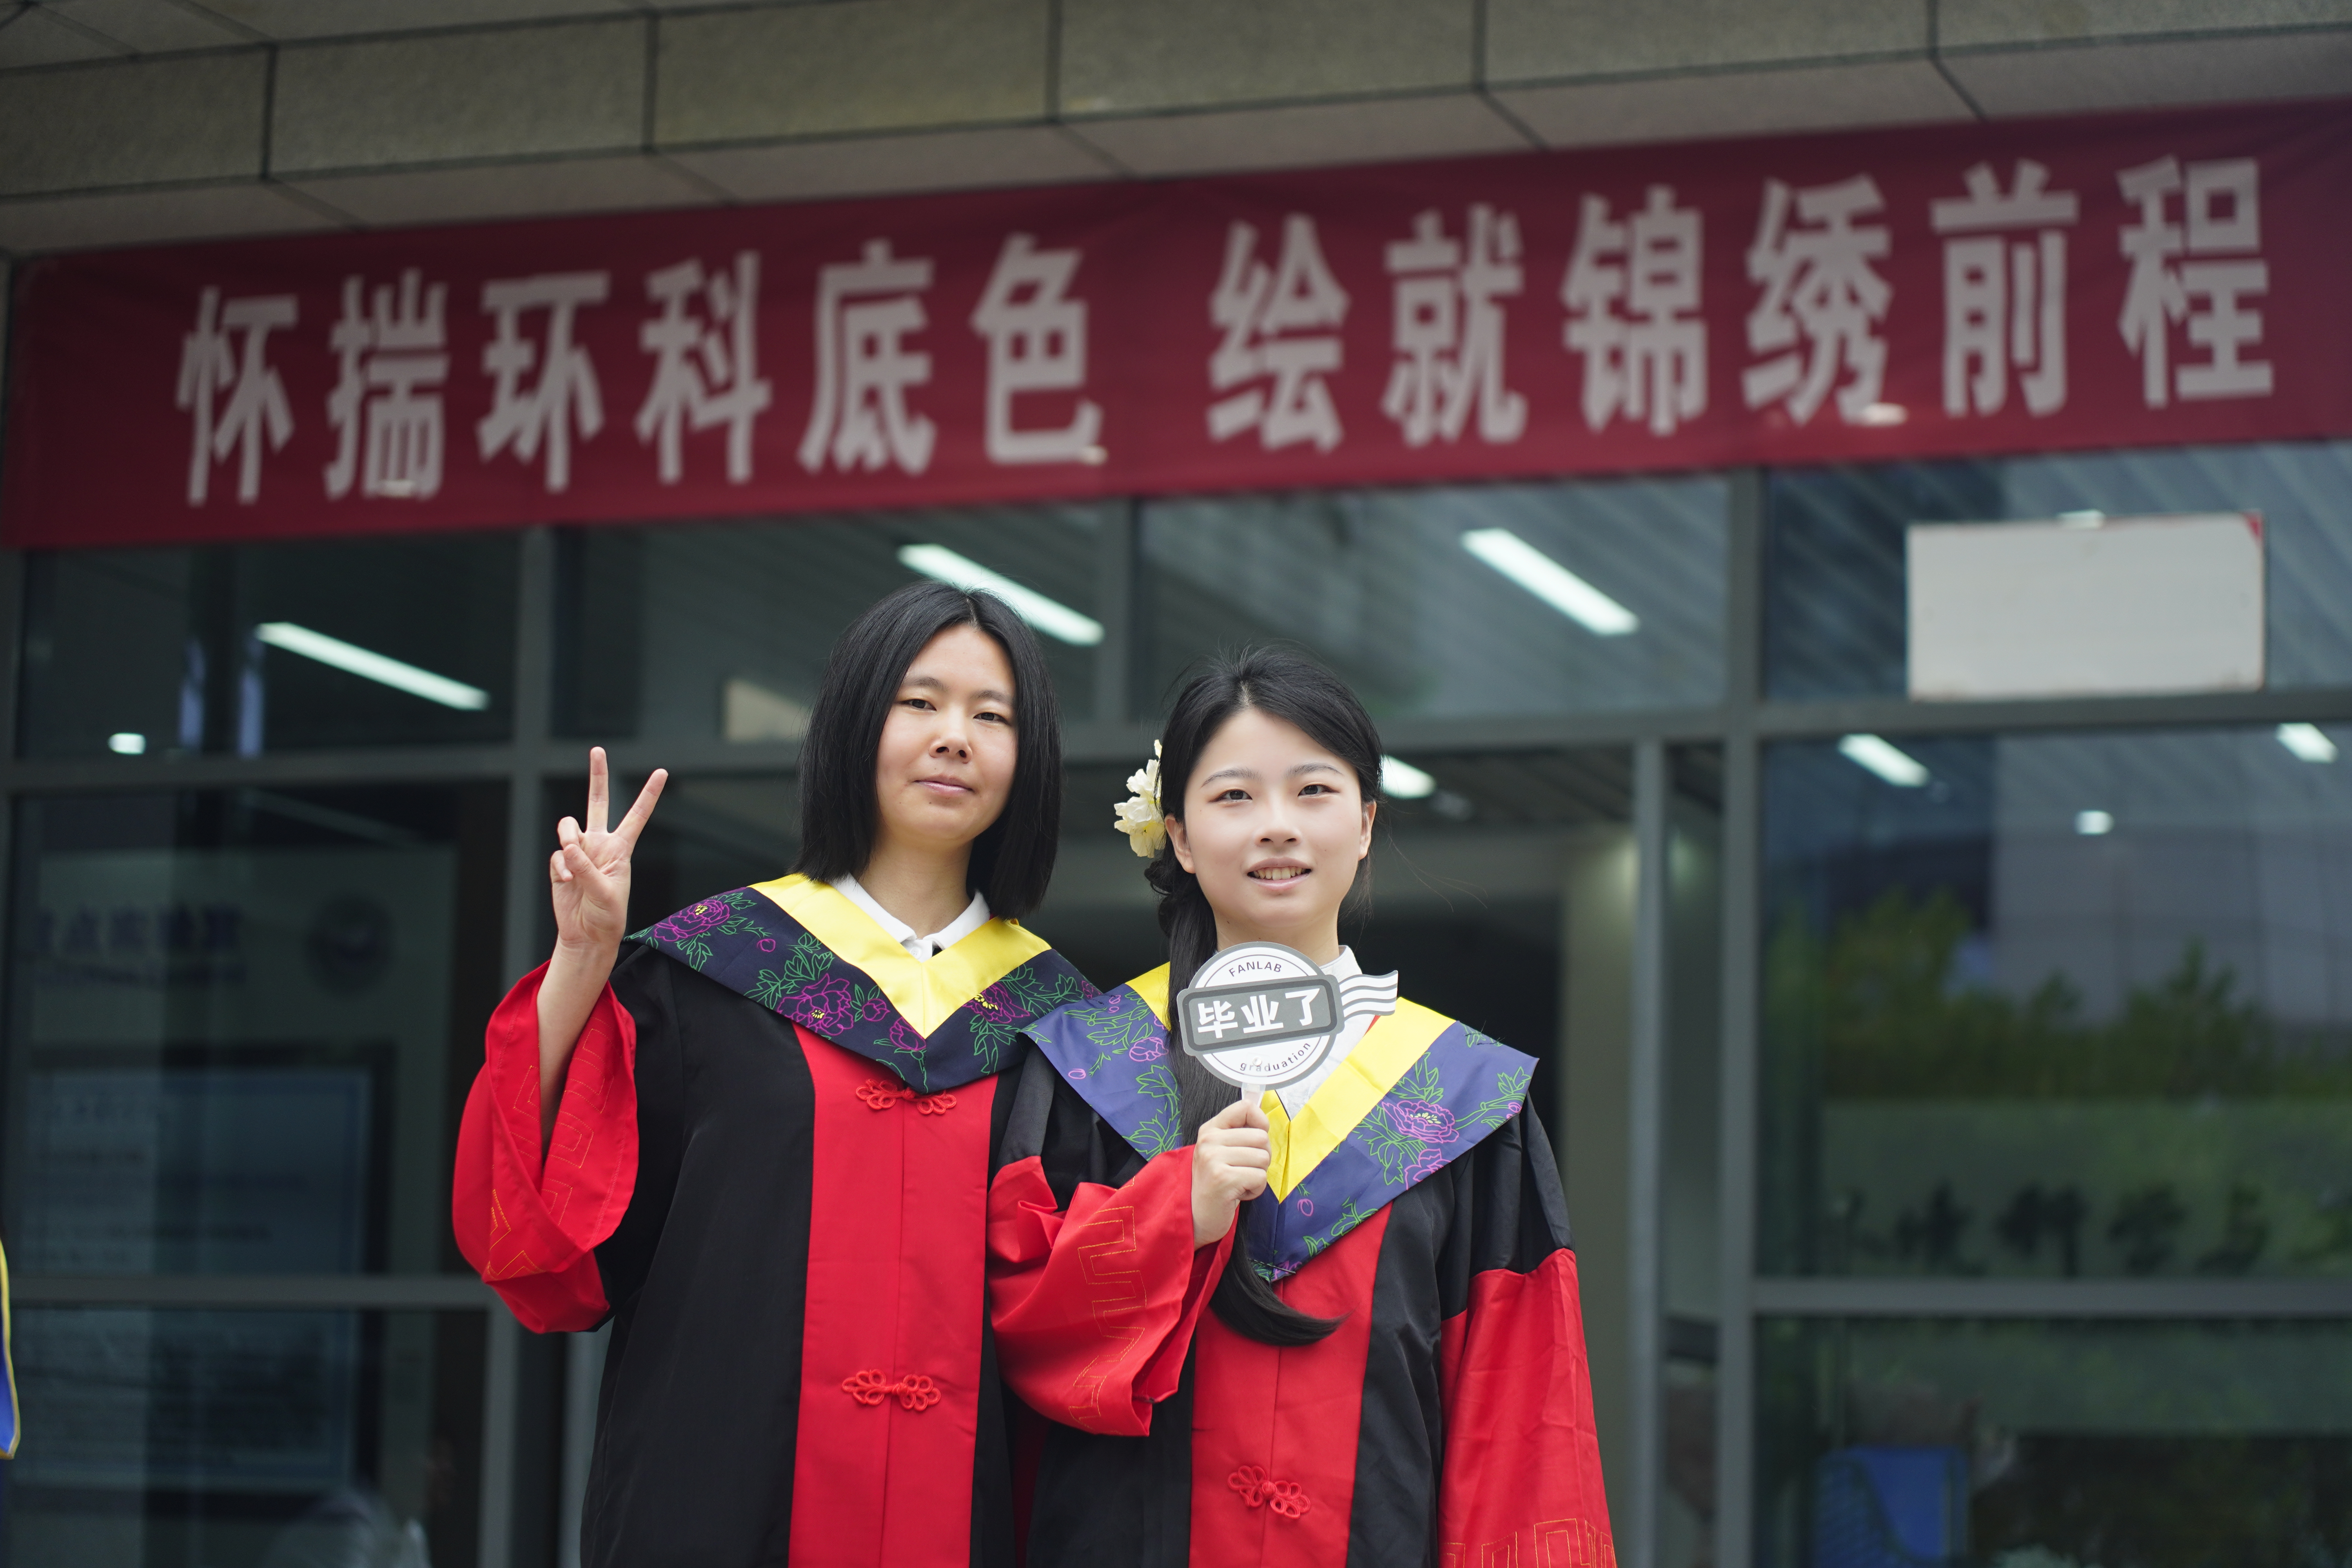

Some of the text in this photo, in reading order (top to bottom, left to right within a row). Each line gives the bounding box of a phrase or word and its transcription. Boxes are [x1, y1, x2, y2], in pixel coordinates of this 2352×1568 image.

[176, 156, 2275, 506] 怀揣环科底色 绘就锦绣前程
[1229, 961, 1282, 977] FANLAB
[1197, 987, 1320, 1038] 毕业了
[1240, 1042, 1311, 1072] graduation
